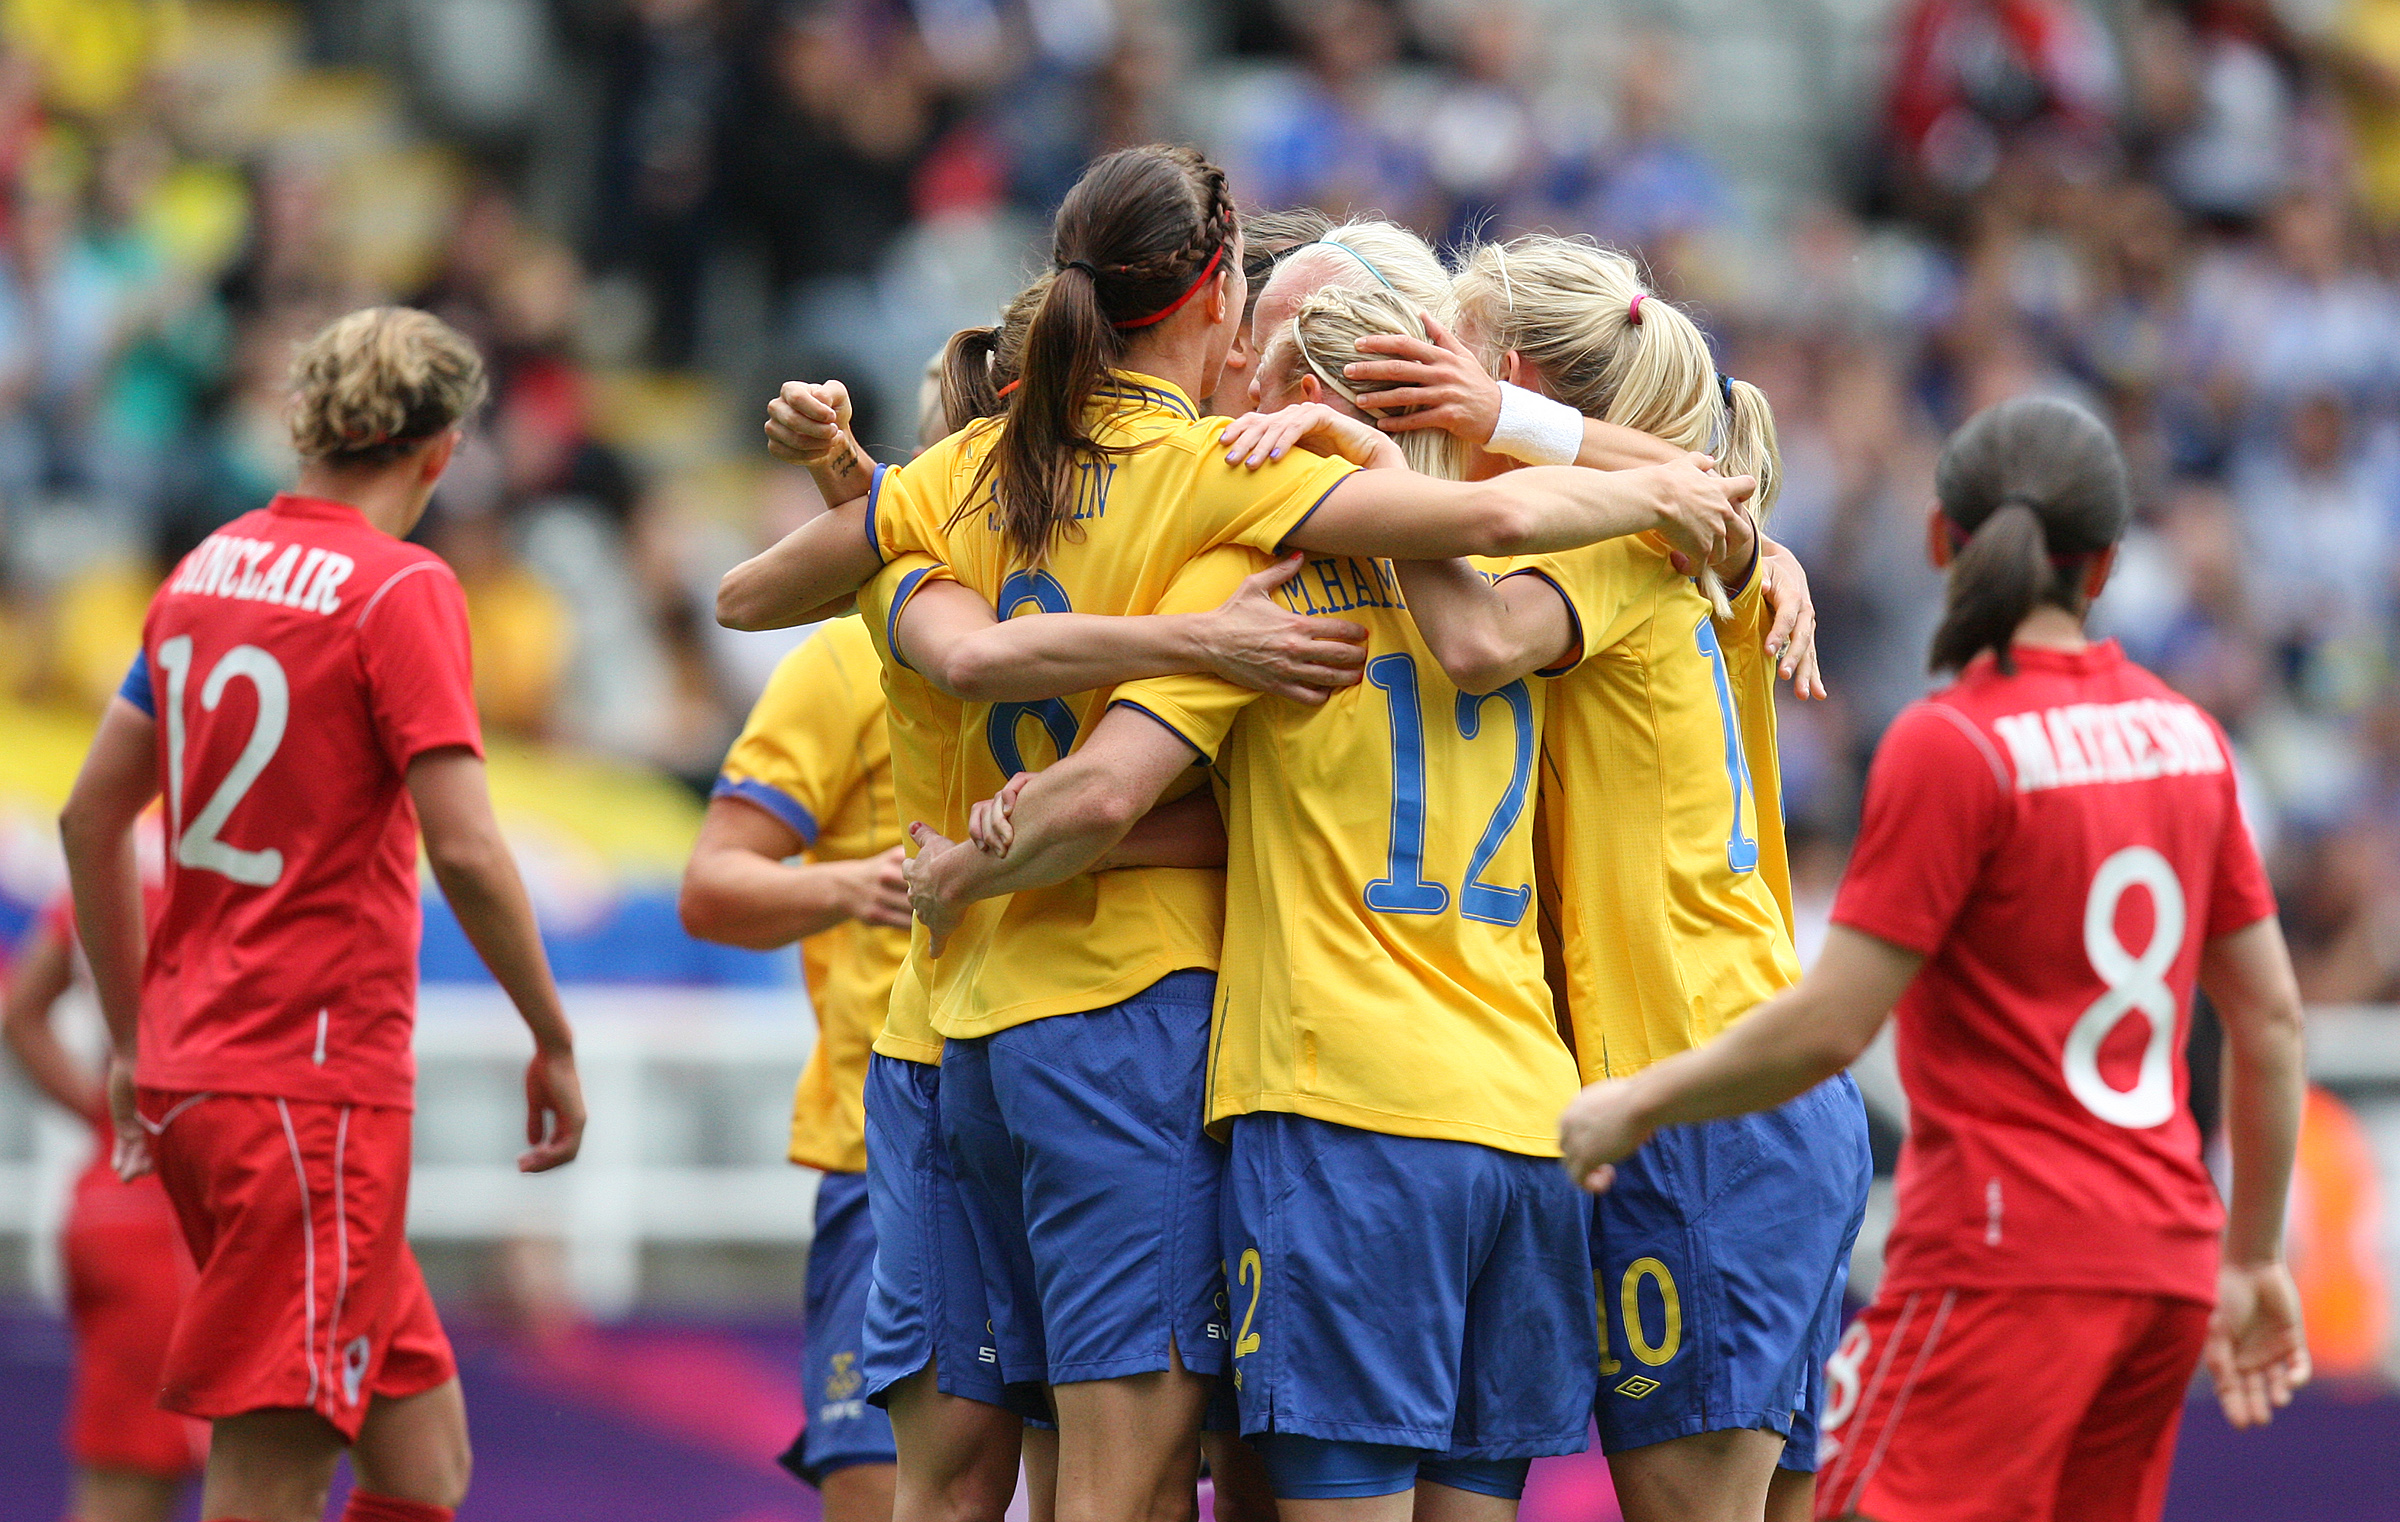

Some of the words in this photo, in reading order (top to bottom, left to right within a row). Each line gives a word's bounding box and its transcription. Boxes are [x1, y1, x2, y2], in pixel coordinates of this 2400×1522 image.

[157, 634, 289, 886] 12
[1363, 652, 1533, 928] 12
[2063, 846, 2185, 1129] 8
[1593, 1256, 1682, 1376] 10
